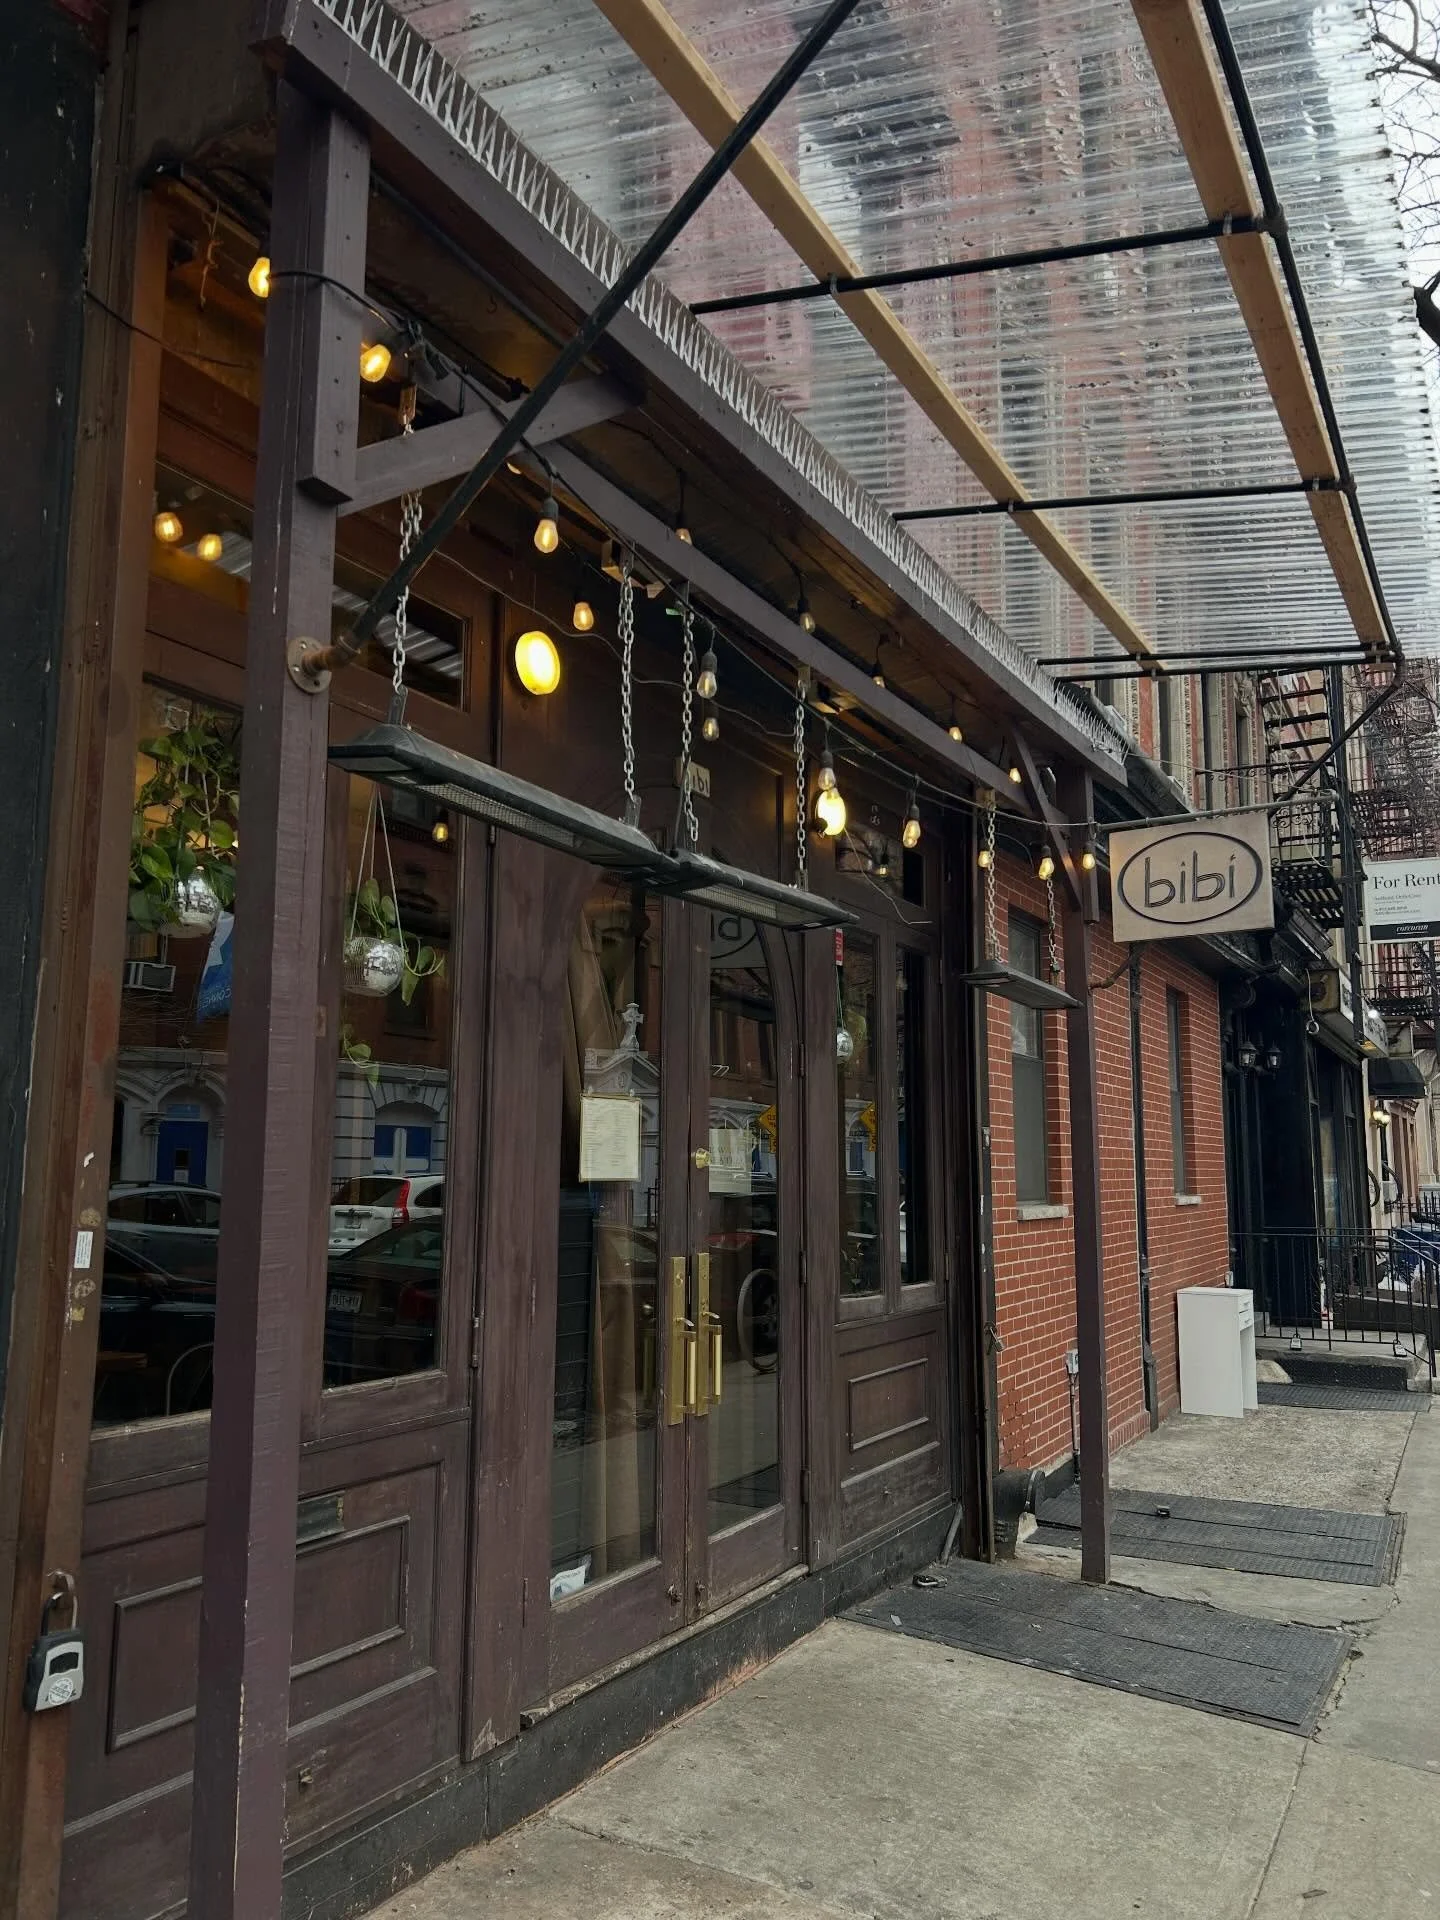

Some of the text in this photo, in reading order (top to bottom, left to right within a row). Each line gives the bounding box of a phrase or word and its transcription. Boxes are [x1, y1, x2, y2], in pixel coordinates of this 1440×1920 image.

[1144, 850, 1237, 908] bibi
[1372, 873, 1440, 889] For Rent
[1396, 924, 1429, 933] corcoran
